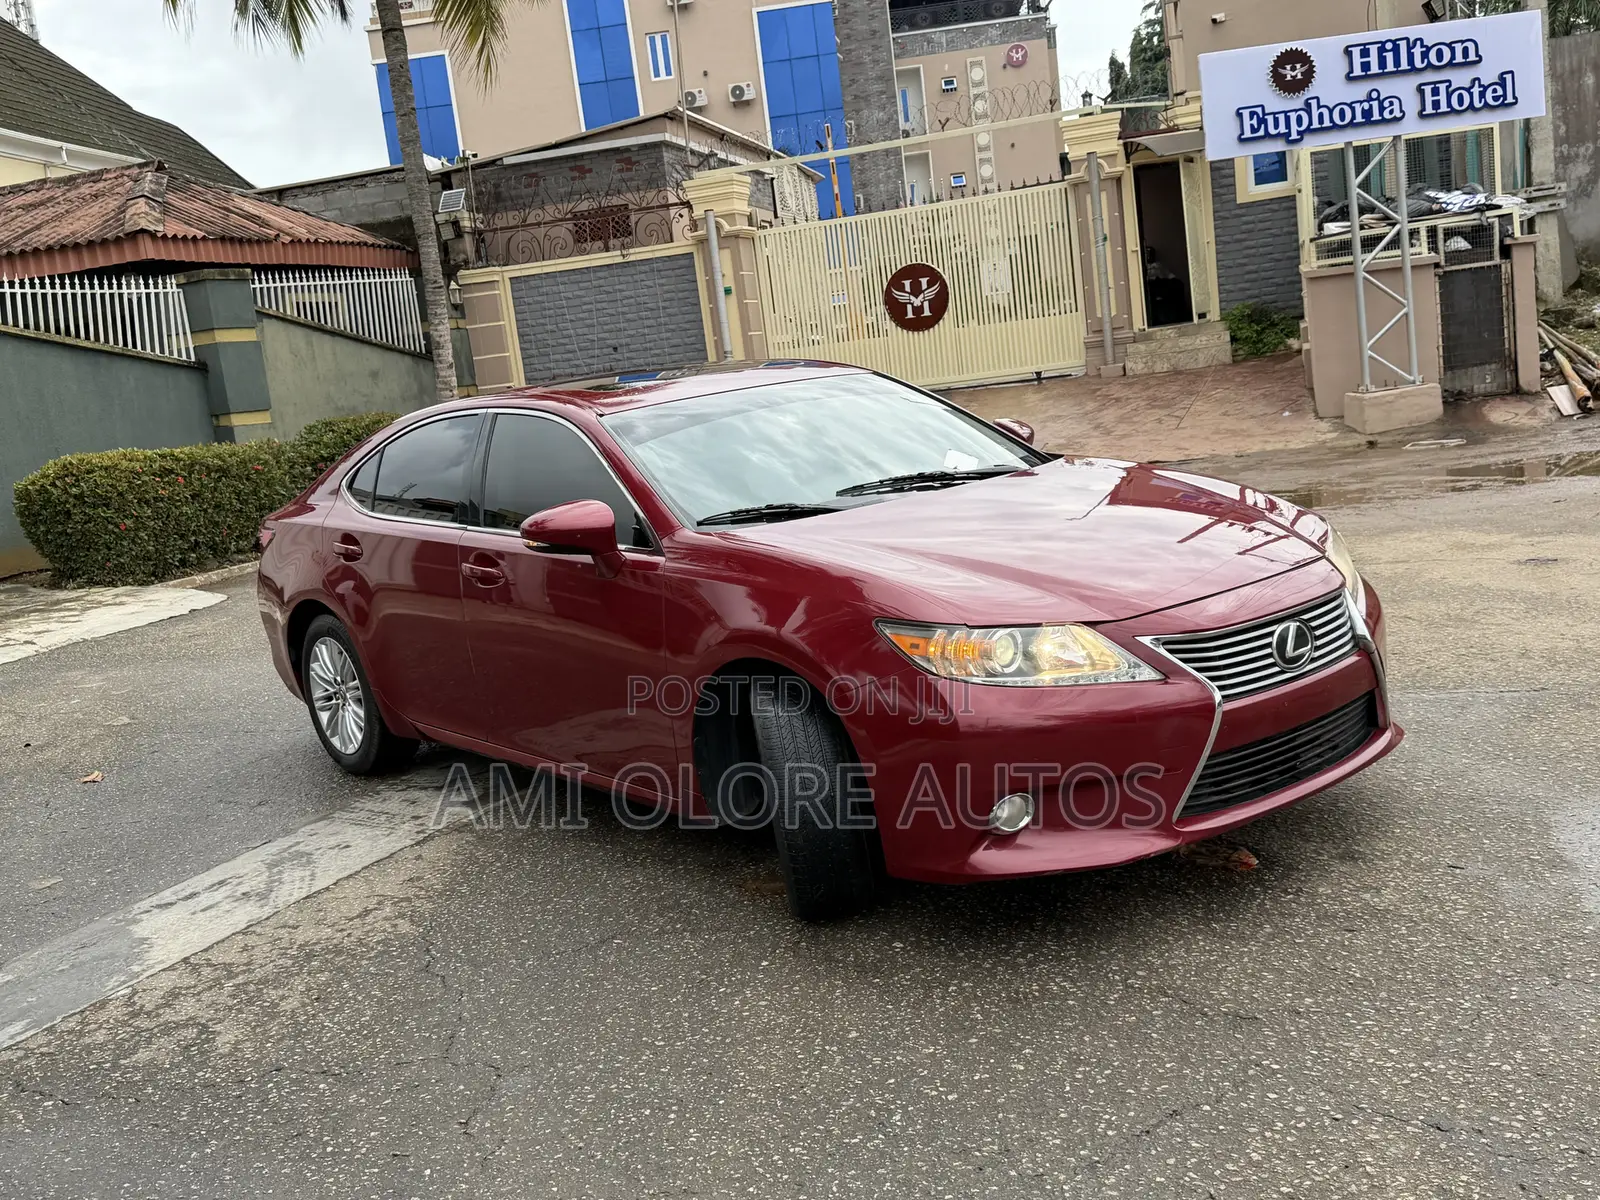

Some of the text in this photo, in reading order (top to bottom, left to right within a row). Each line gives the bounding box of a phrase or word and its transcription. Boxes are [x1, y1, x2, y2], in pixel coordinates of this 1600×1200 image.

[1284, 63, 1304, 80] H
[1346, 38, 1481, 81] Hilton
[1237, 70, 1517, 143] Euphoria Hotel
[901, 276, 933, 319] H
